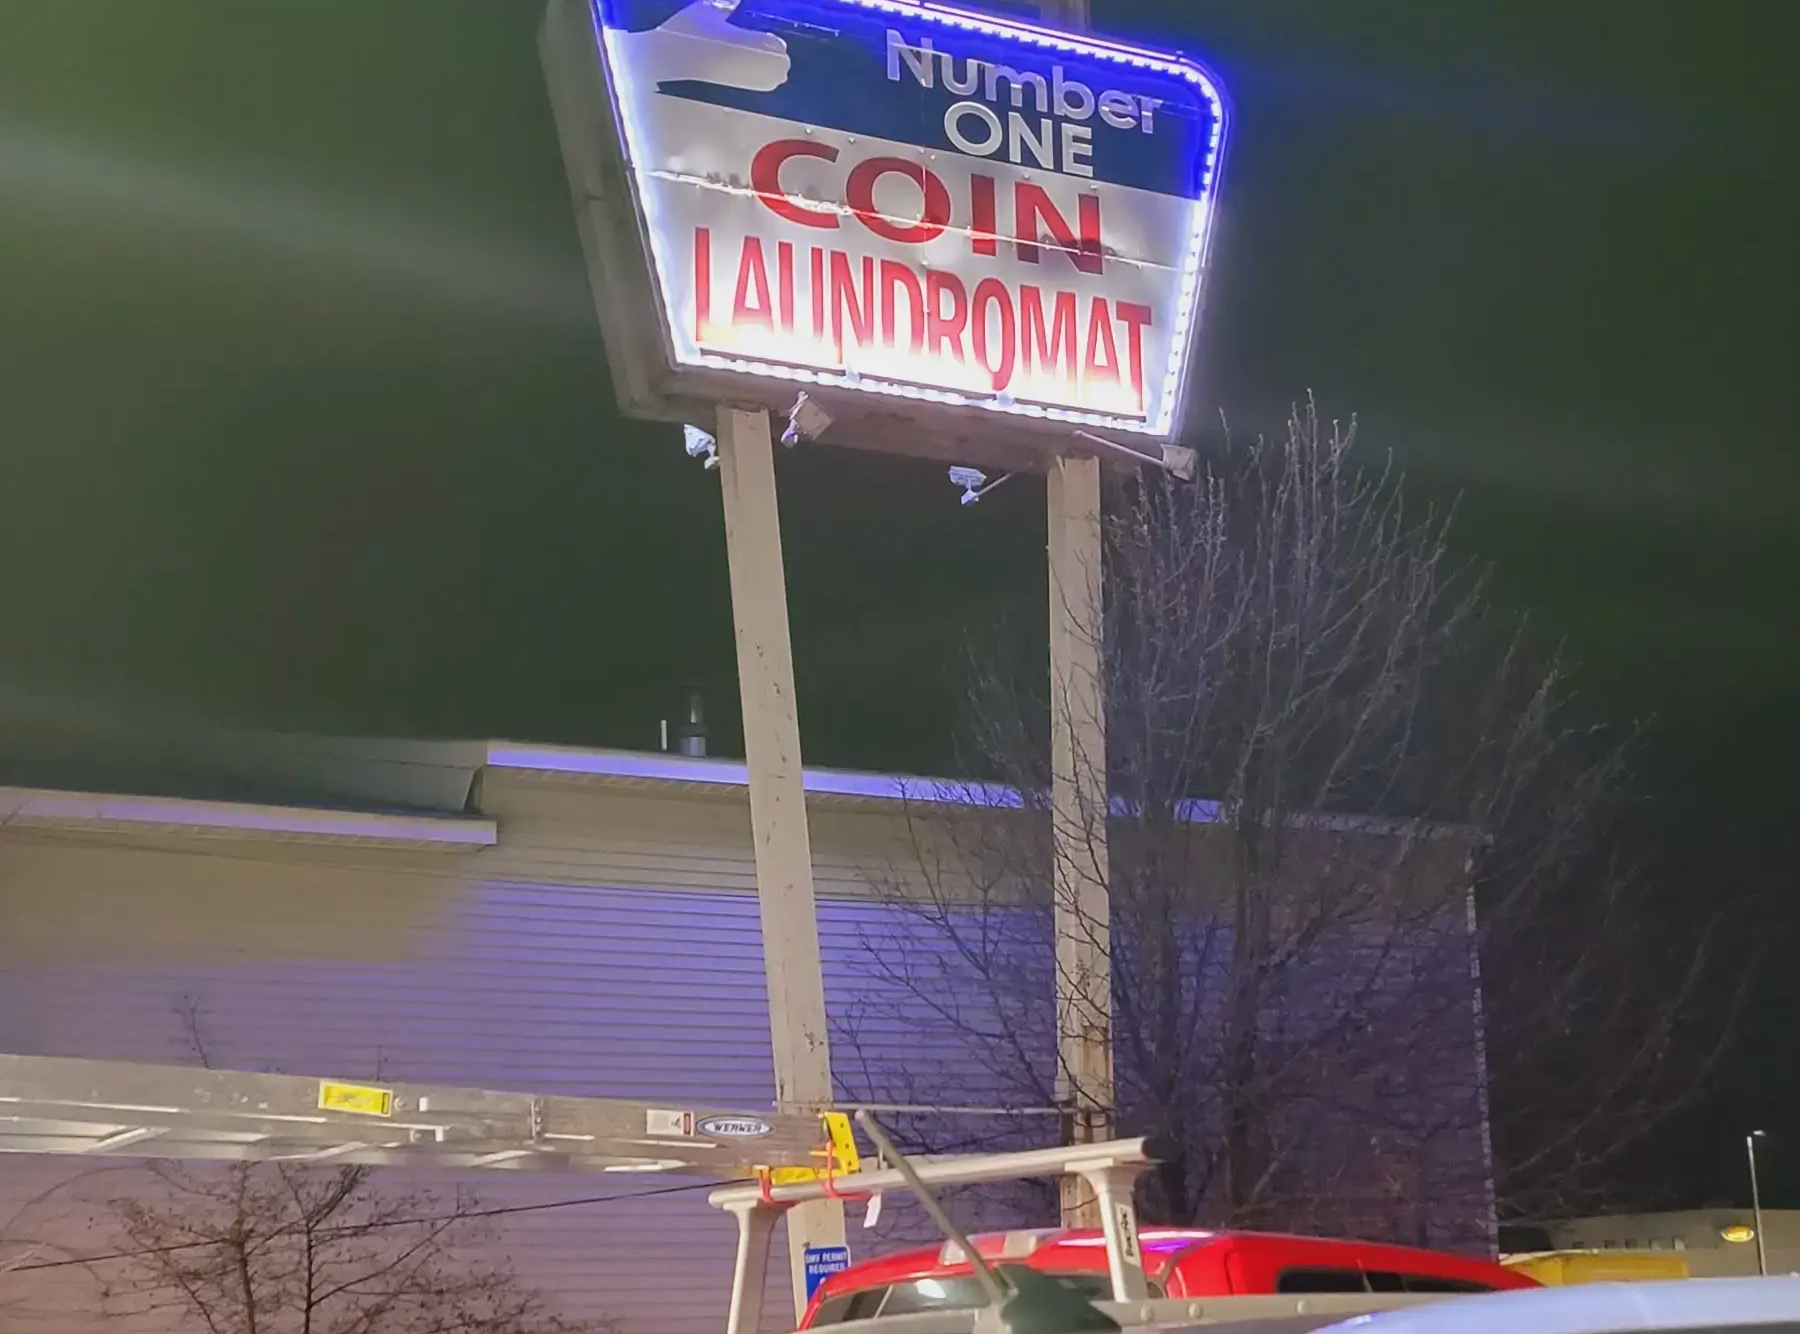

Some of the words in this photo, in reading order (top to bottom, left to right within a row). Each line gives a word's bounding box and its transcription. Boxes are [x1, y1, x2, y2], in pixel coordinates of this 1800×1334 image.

[886, 28, 1164, 134] Number
[944, 101, 1094, 178] ONE
[750, 138, 1104, 275] COIN
[694, 226, 1152, 411] LAUNDROMAT
[714, 1122, 763, 1133] WERNER
